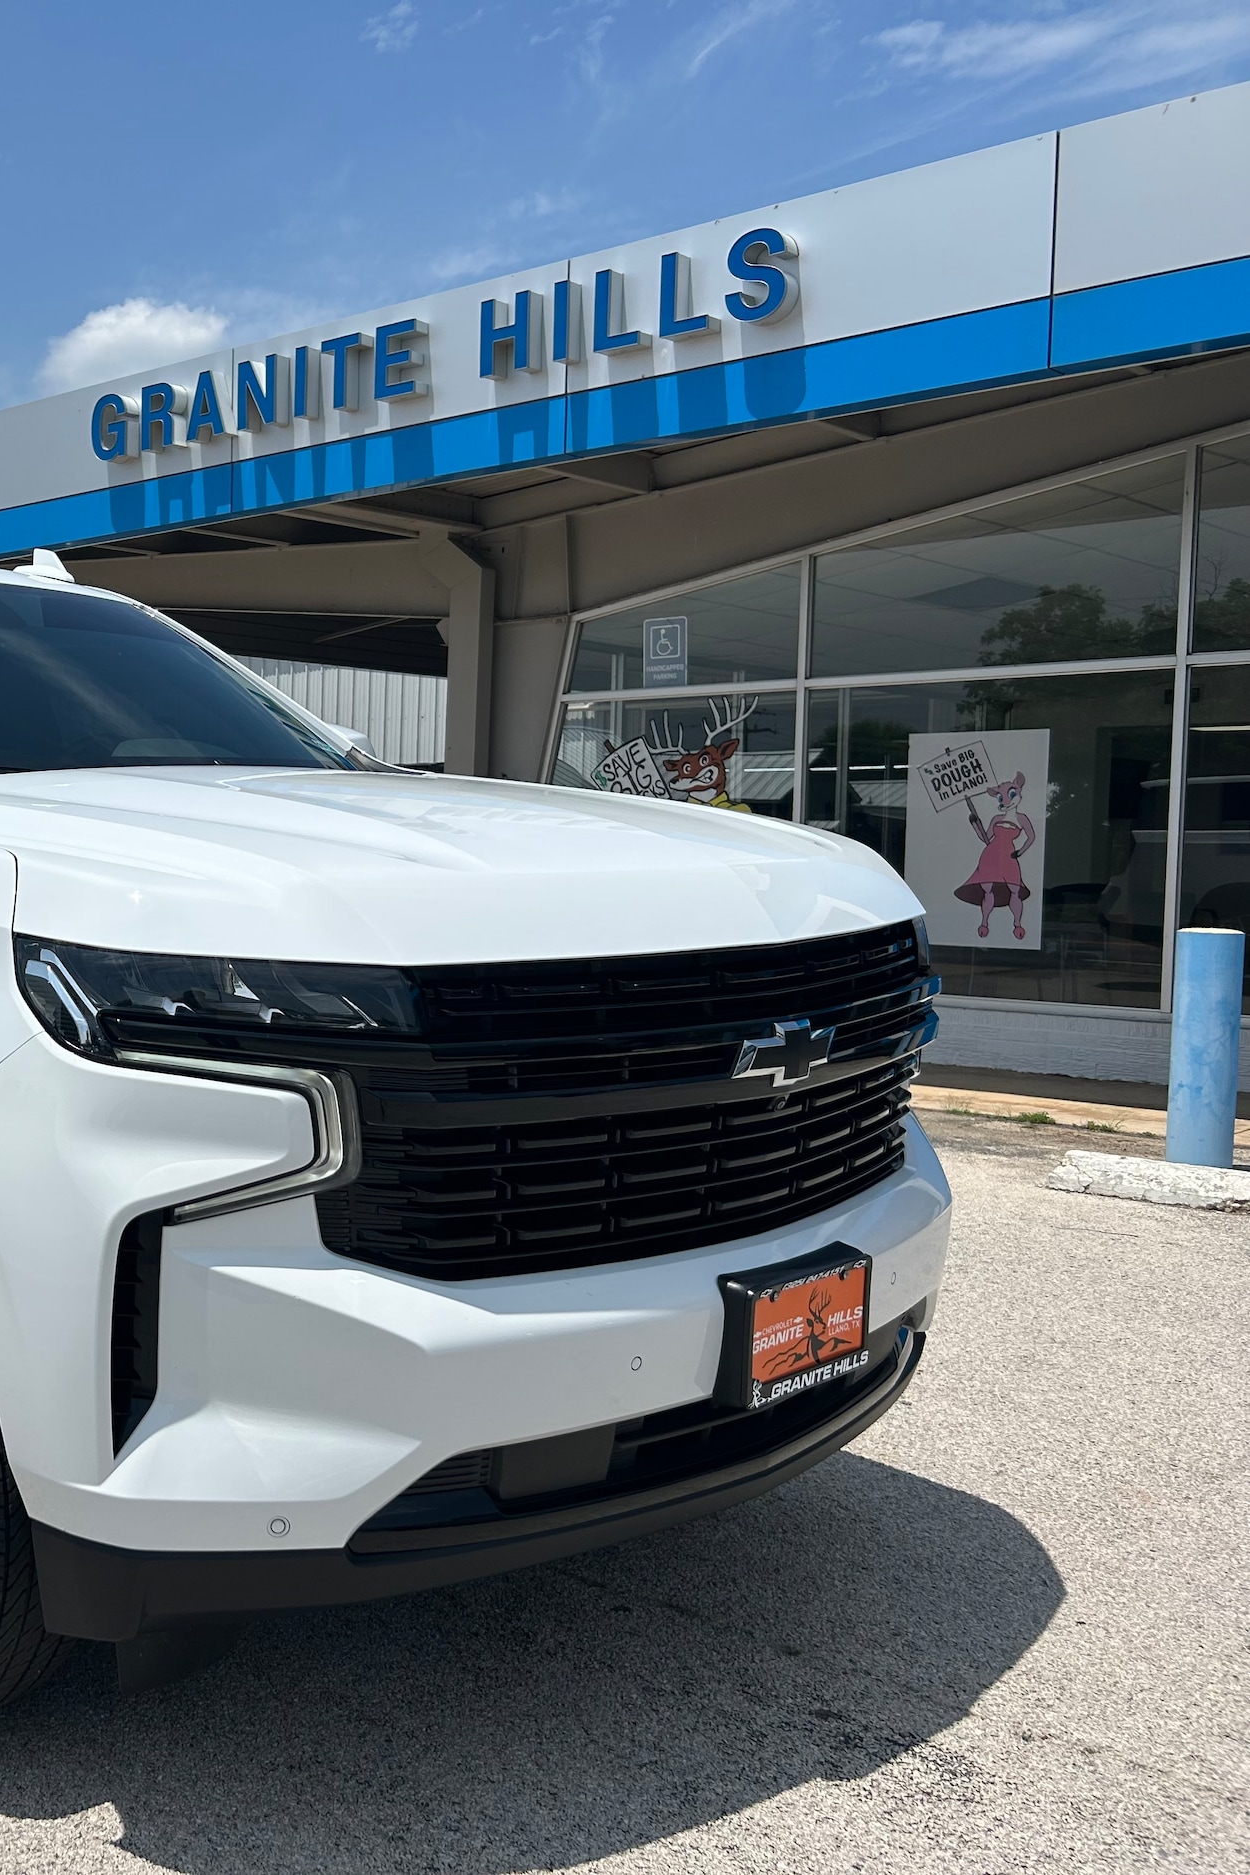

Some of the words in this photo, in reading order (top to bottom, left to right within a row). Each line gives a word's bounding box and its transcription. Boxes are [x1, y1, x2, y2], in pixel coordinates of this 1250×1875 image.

[91, 318, 428, 463] GRANITE
[479, 227, 798, 380] HILLS
[646, 663, 685, 672] HANDICAPPED
[652, 672, 677, 680] PARKING
[934, 759, 958, 773] Save
[958, 749, 975, 763] BIG
[931, 758, 983, 792] DOUGH
[949, 772, 988, 796] LLANO!
[752, 1323, 804, 1355] GRANITE
[827, 1305, 864, 1327] HILLS
[762, 1320, 794, 1336] CHEVROLET
[850, 1319, 861, 1329] TX
[771, 1363, 832, 1399] GRANITE
[833, 1350, 869, 1377] HILLS
